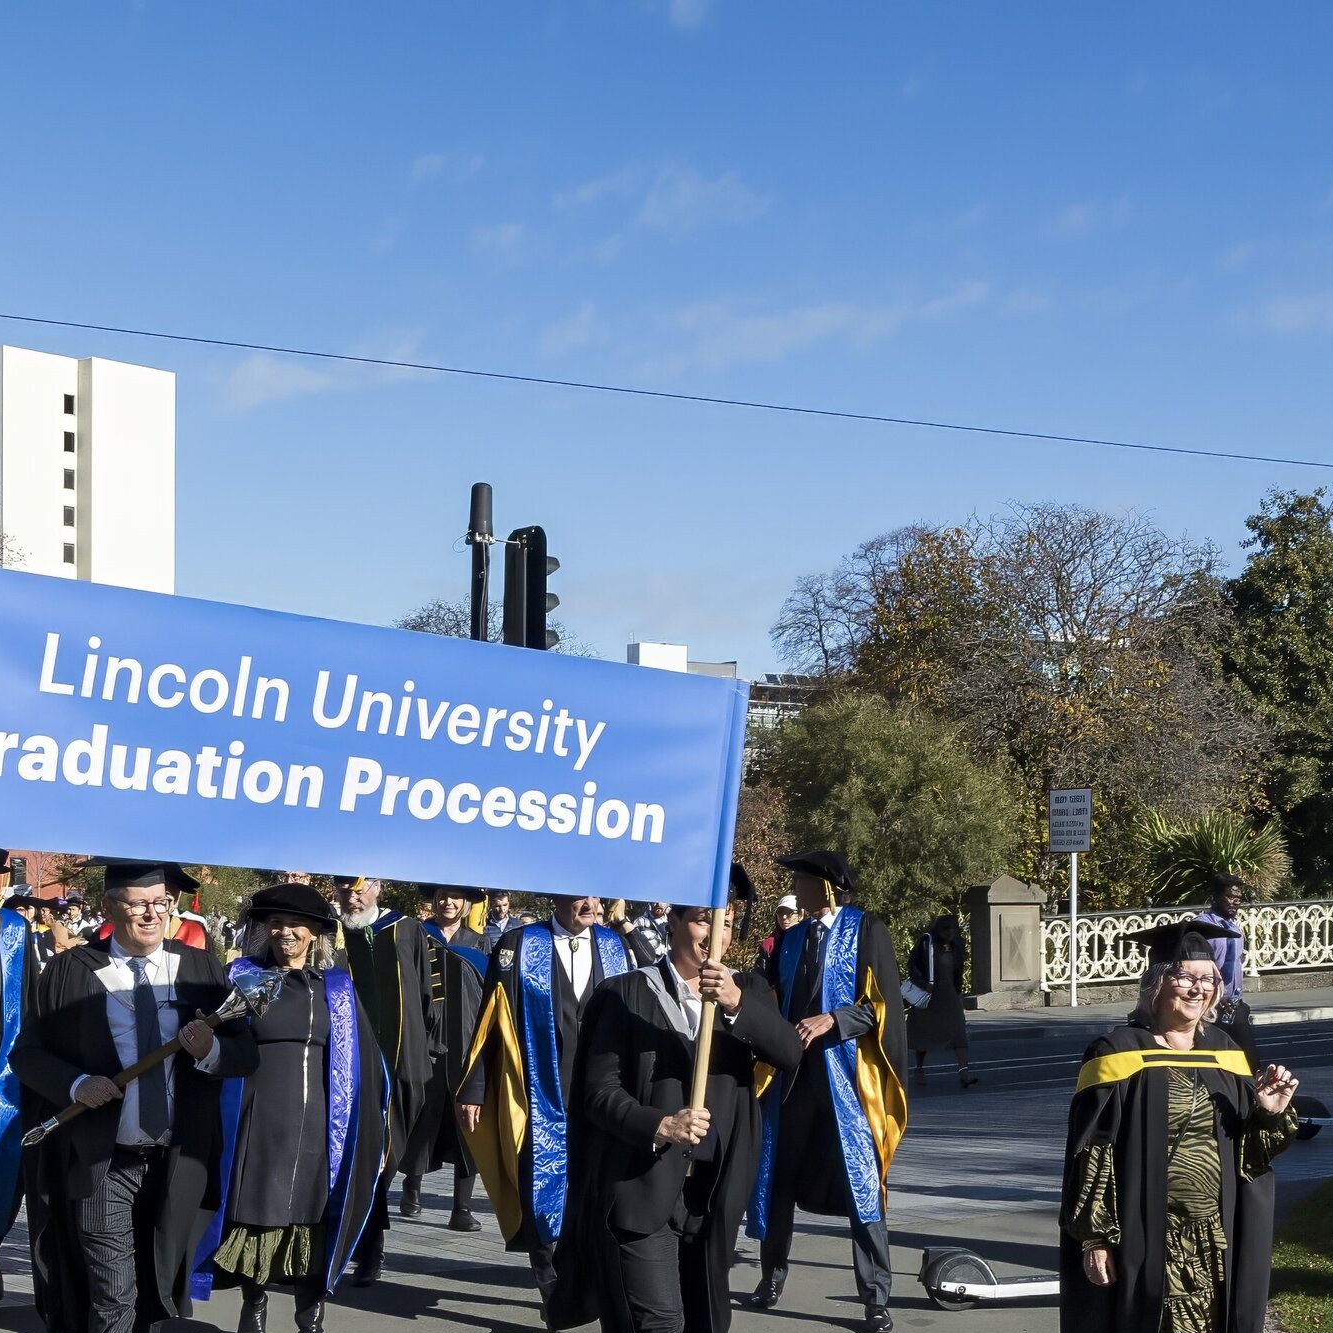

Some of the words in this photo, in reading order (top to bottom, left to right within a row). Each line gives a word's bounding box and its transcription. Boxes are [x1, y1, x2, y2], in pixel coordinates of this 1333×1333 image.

[39, 632, 289, 722] Lincoln
[312, 670, 606, 771] University
[339, 756, 665, 843] Procession
